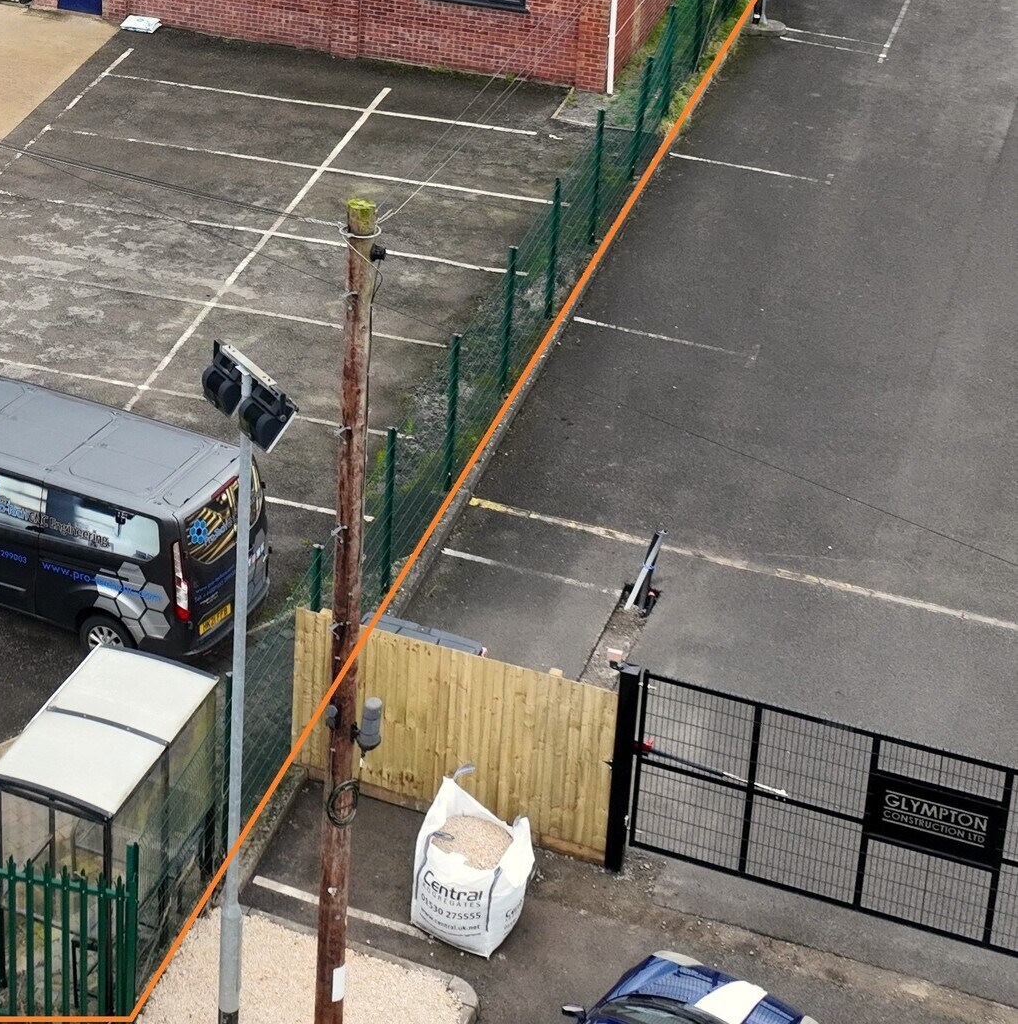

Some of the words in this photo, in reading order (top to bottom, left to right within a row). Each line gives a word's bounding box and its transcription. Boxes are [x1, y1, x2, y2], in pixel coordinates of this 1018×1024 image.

[49, 516, 111, 549] Engineering
[0, 547, 28, 564] 299003
[883, 809, 965, 839] CONSTRUCTION
[968, 832, 985, 843] LTD
[884, 793, 988, 832] GLYMPTON
[423, 870, 484, 902] Central
[420, 893, 444, 916] 01530
[445, 910, 482, 921] 275555
